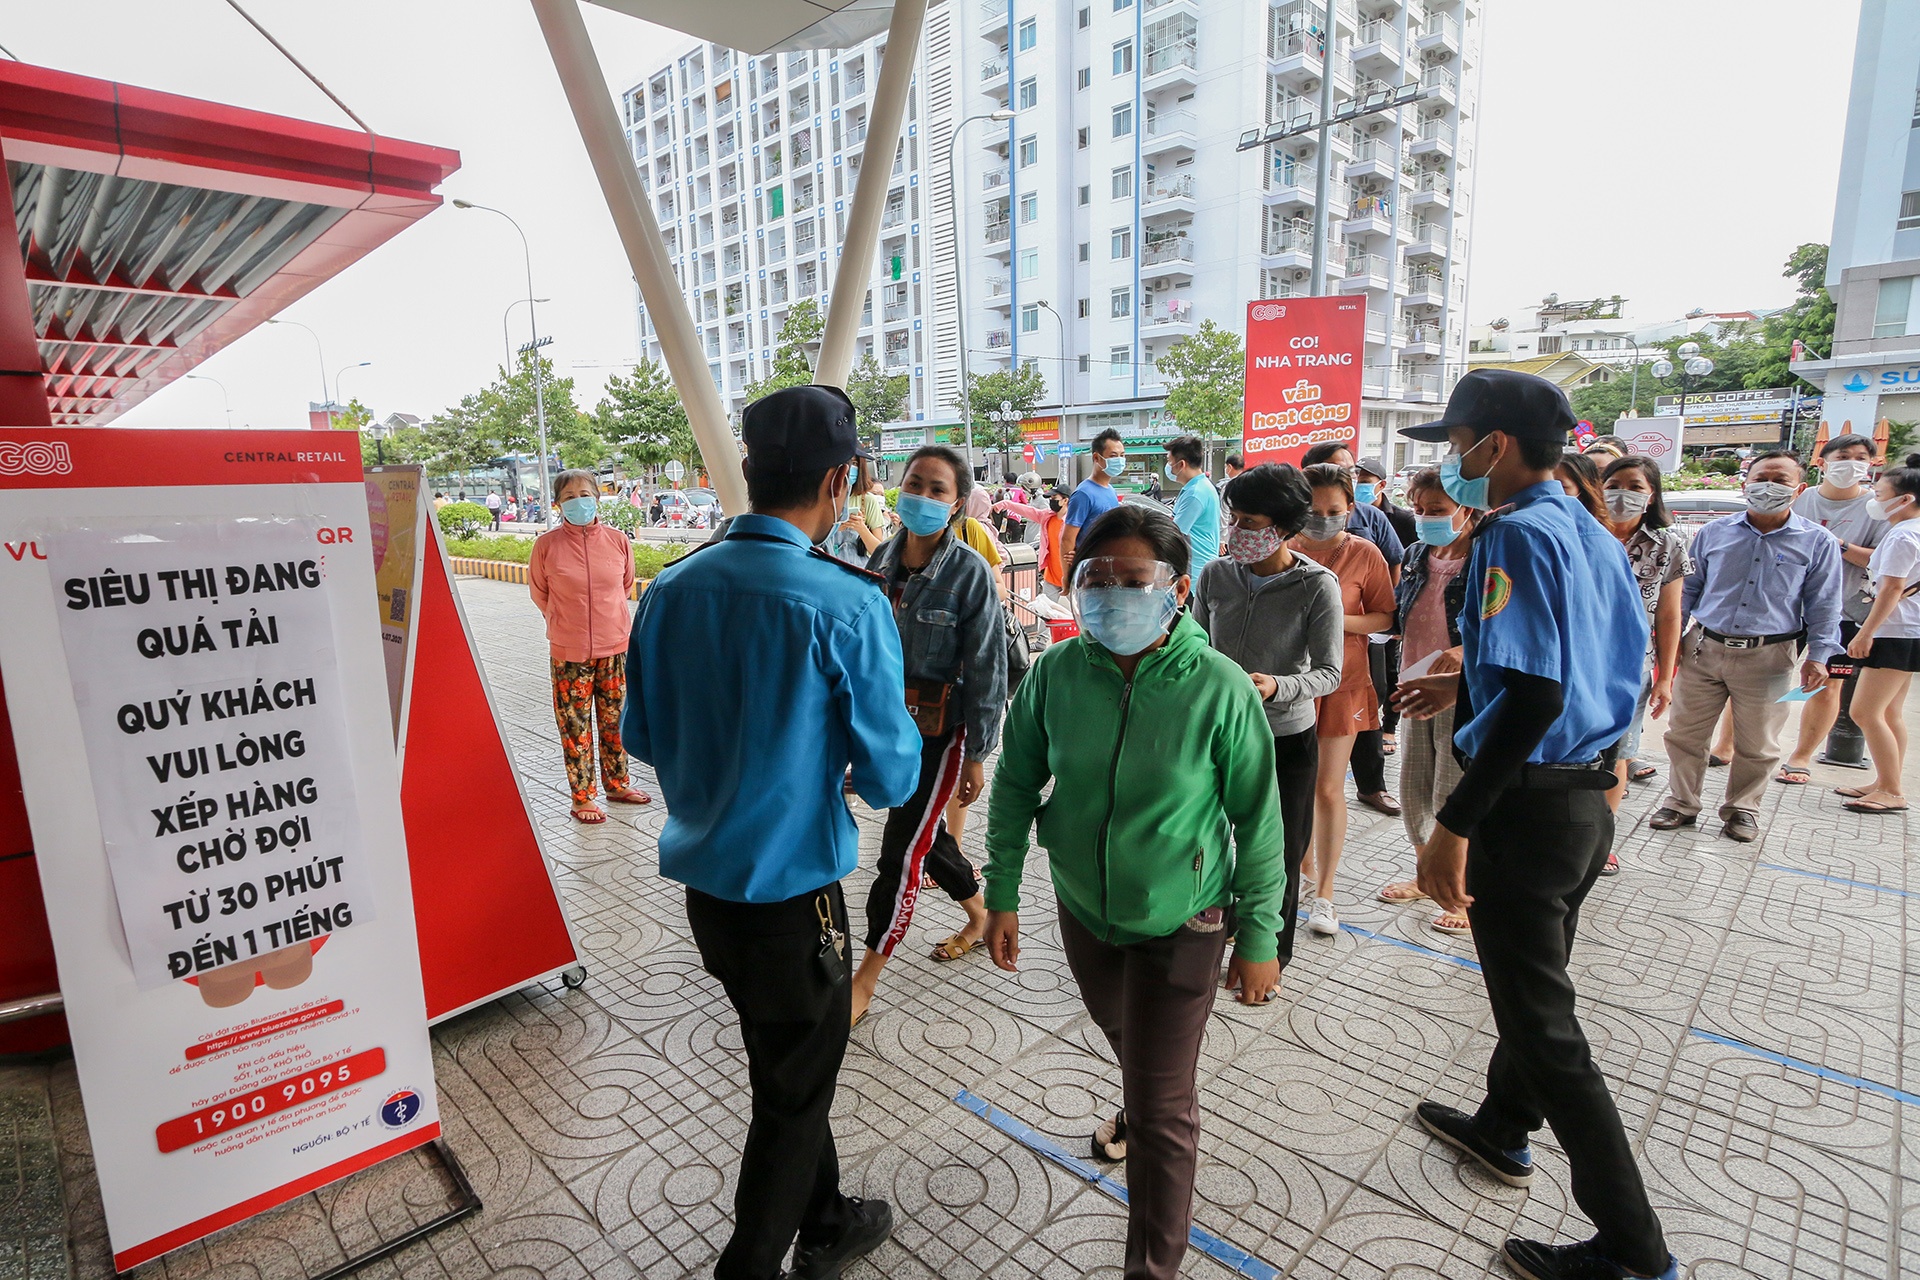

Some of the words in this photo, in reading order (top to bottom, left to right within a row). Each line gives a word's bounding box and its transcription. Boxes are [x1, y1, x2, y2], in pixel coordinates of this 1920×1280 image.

[1289, 336, 1319, 349] GO!
[1255, 356, 1291, 368] NHA
[1295, 353, 1352, 367] TRANG
[1283, 380, 1320, 402] vẫn
[1673, 395, 1713, 405] MOKA
[1715, 390, 1773, 402] COFFEE
[1253, 410, 1297, 430] hoạt
[1300, 404, 1350, 425] động
[1247, 437, 1263, 452] từ
[1264, 434, 1299, 449] 8h00
[1310, 428, 1354, 443] 22h00
[0, 441, 73, 475] GO!
[388, 480, 416, 490] CENTRAL
[317, 527, 353, 544] QR
[65, 567, 150, 610] SIÊU
[158, 568, 219, 604] THỊ
[226, 559, 321, 596] ĐANG
[137, 616, 216, 659] QUÁ
[222, 608, 279, 649] TẢI
[117, 689, 191, 734] QUÝ
[201, 677, 317, 721] KHÁCH
[146, 746, 209, 783] VUI
[216, 730, 306, 771] LÒNG
[152, 790, 218, 837] XẾP
[226, 777, 318, 820] HÀNG
[177, 827, 247, 874] CHỜ
[255, 815, 312, 854] ĐỢI
[163, 887, 210, 930] TỪ
[218, 882, 258, 917] 30
[265, 856, 344, 903] PHÚT
[890, 886, 917, 941] TOMMY
[168, 933, 238, 979] ĐẾN
[242, 930, 258, 955] 1
[263, 903, 353, 948] TIẾNG
[232, 1021, 249, 1033] app
[251, 1009, 287, 1026] Bluezone
[251, 1037, 272, 1051] nguy
[326, 1007, 361, 1024] Covid-19
[211, 1090, 227, 1103] gọi
[280, 1064, 303, 1079] nóng
[335, 1048, 343, 1058] Y
[237, 1060, 252, 1071] Khi
[254, 1054, 266, 1064] có
[273, 1056, 292, 1069] KHÓ
[193, 1096, 266, 1134] 1900
[282, 1065, 351, 1102] 9095
[315, 1109, 327, 1119] an
[352, 1121, 360, 1131] Y
[236, 1126, 258, 1141] quan
